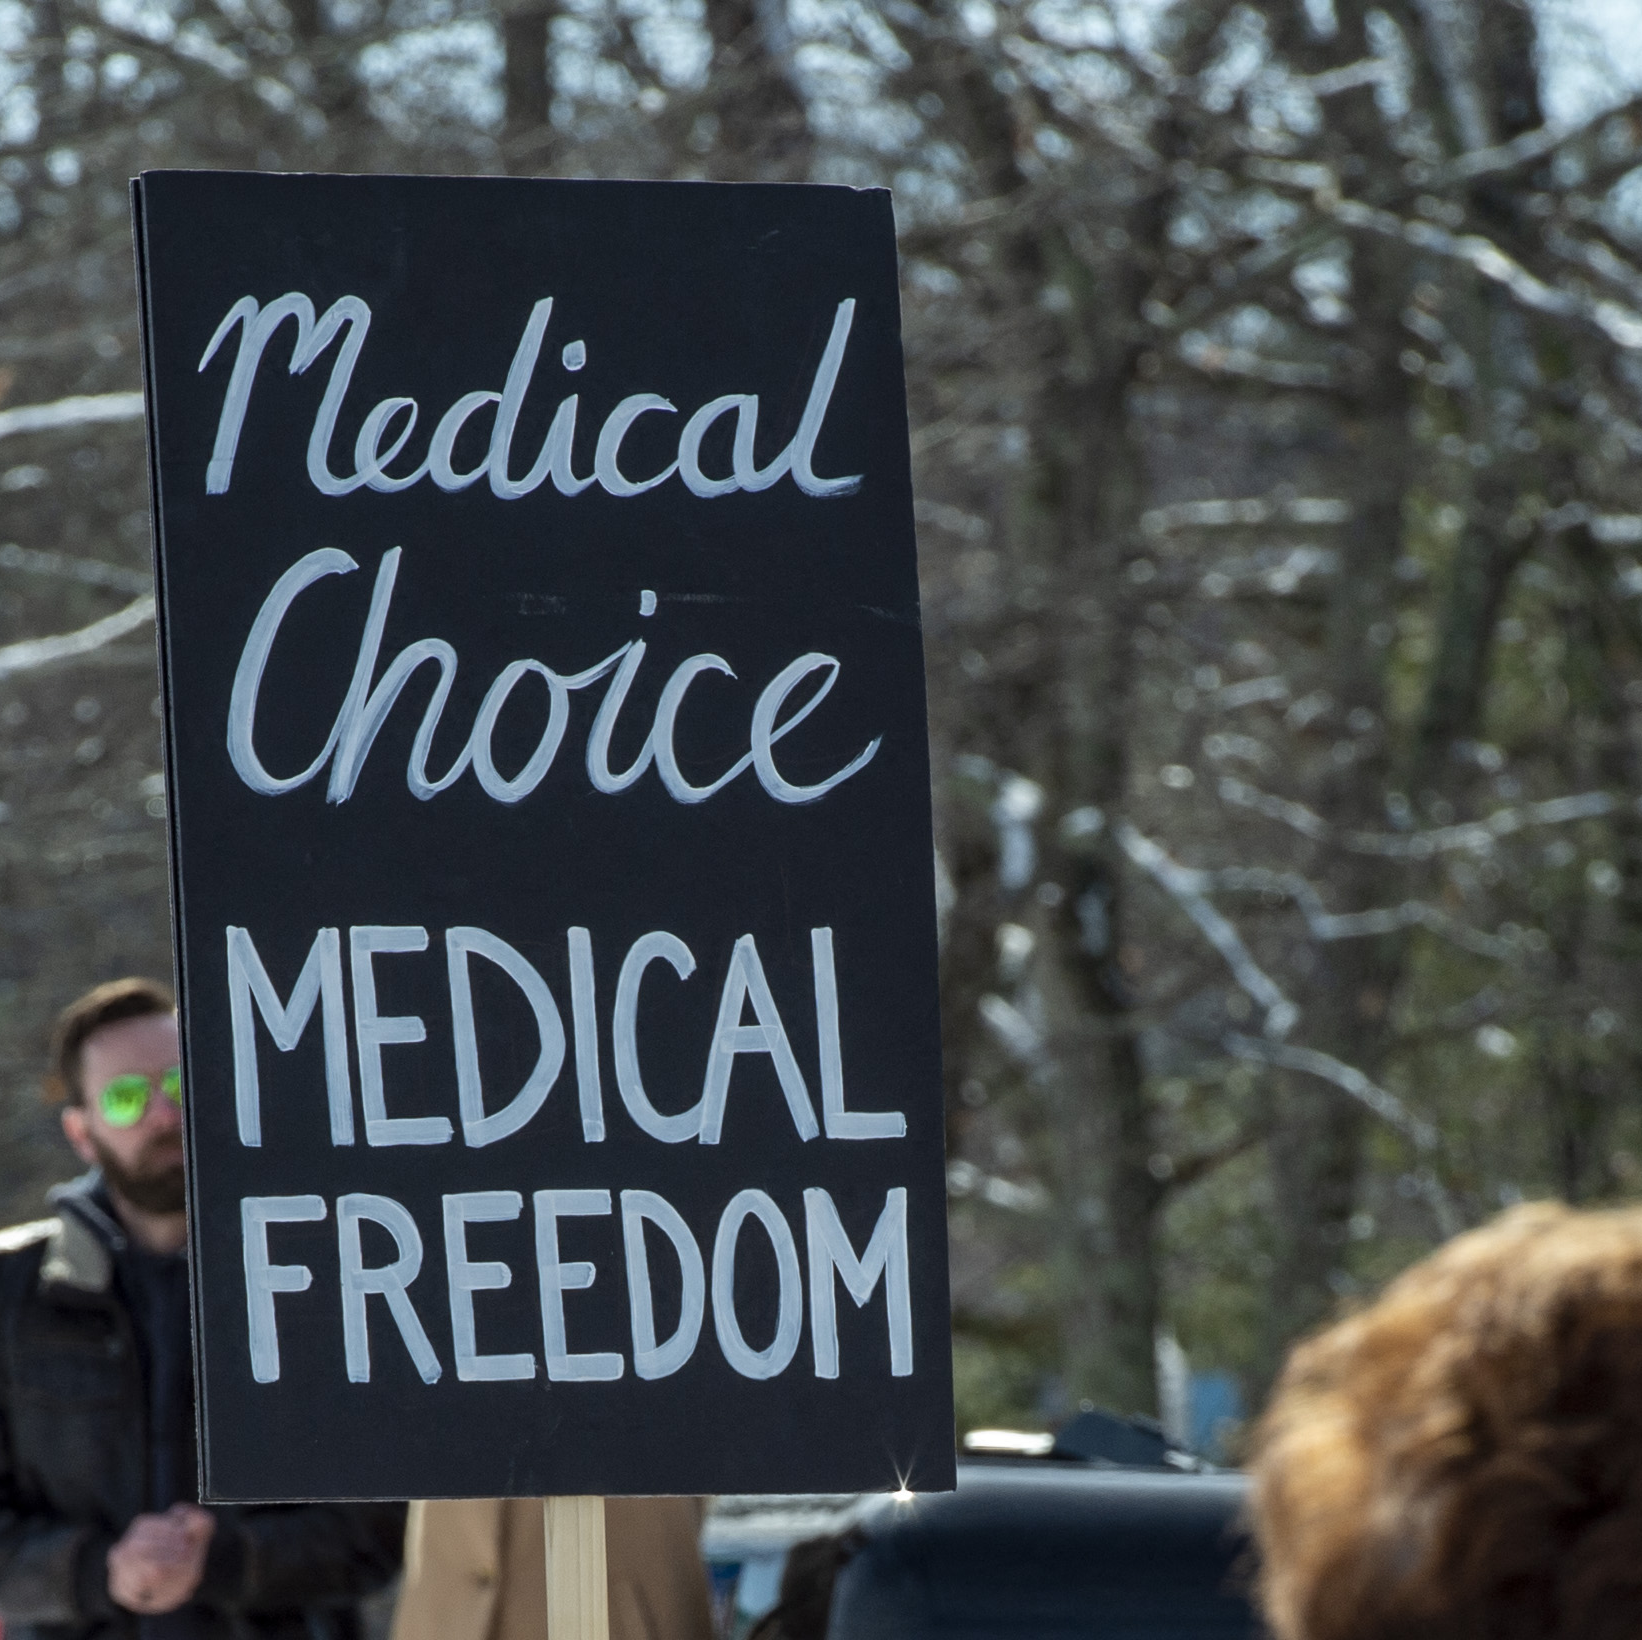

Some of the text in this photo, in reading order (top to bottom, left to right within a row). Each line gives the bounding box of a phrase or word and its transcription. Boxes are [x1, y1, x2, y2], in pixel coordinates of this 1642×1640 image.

[197, 291, 864, 499] Medical
[226, 545, 883, 806] Choice
[225, 924, 908, 1148] MEDICAL
[240, 1186, 913, 1384] FREEDOM
